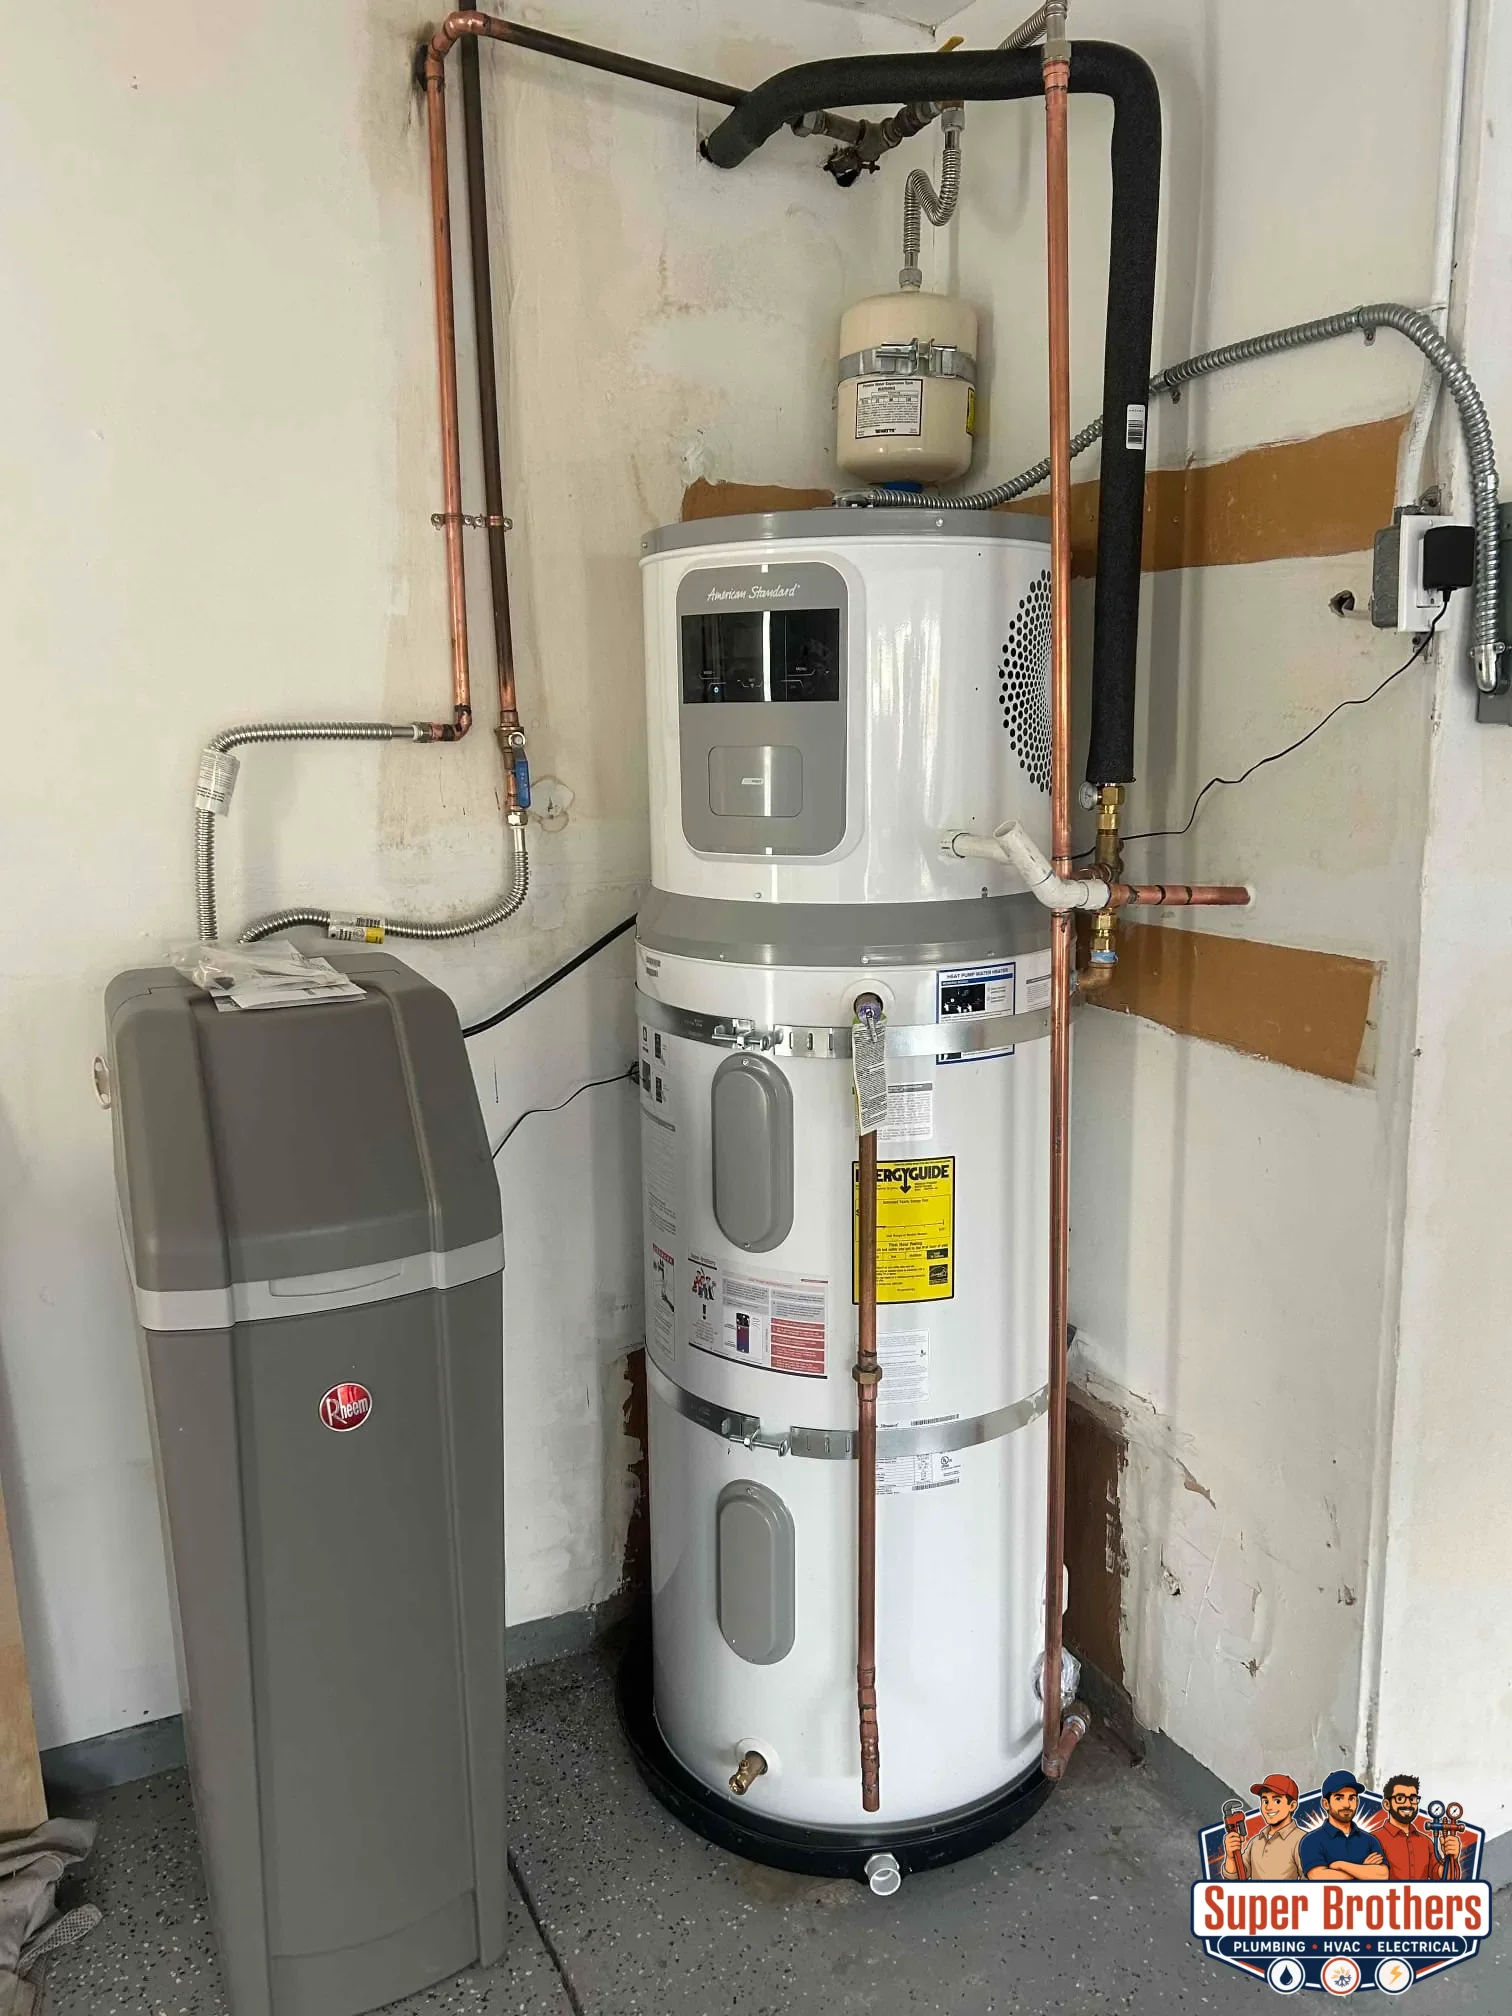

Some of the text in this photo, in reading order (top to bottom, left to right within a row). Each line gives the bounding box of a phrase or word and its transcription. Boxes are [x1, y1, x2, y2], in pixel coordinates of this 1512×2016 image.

[707, 584, 797, 601] American Standard
[856, 1165, 950, 1182] ERGYGUIDE
[326, 1388, 368, 1426] Rheem
